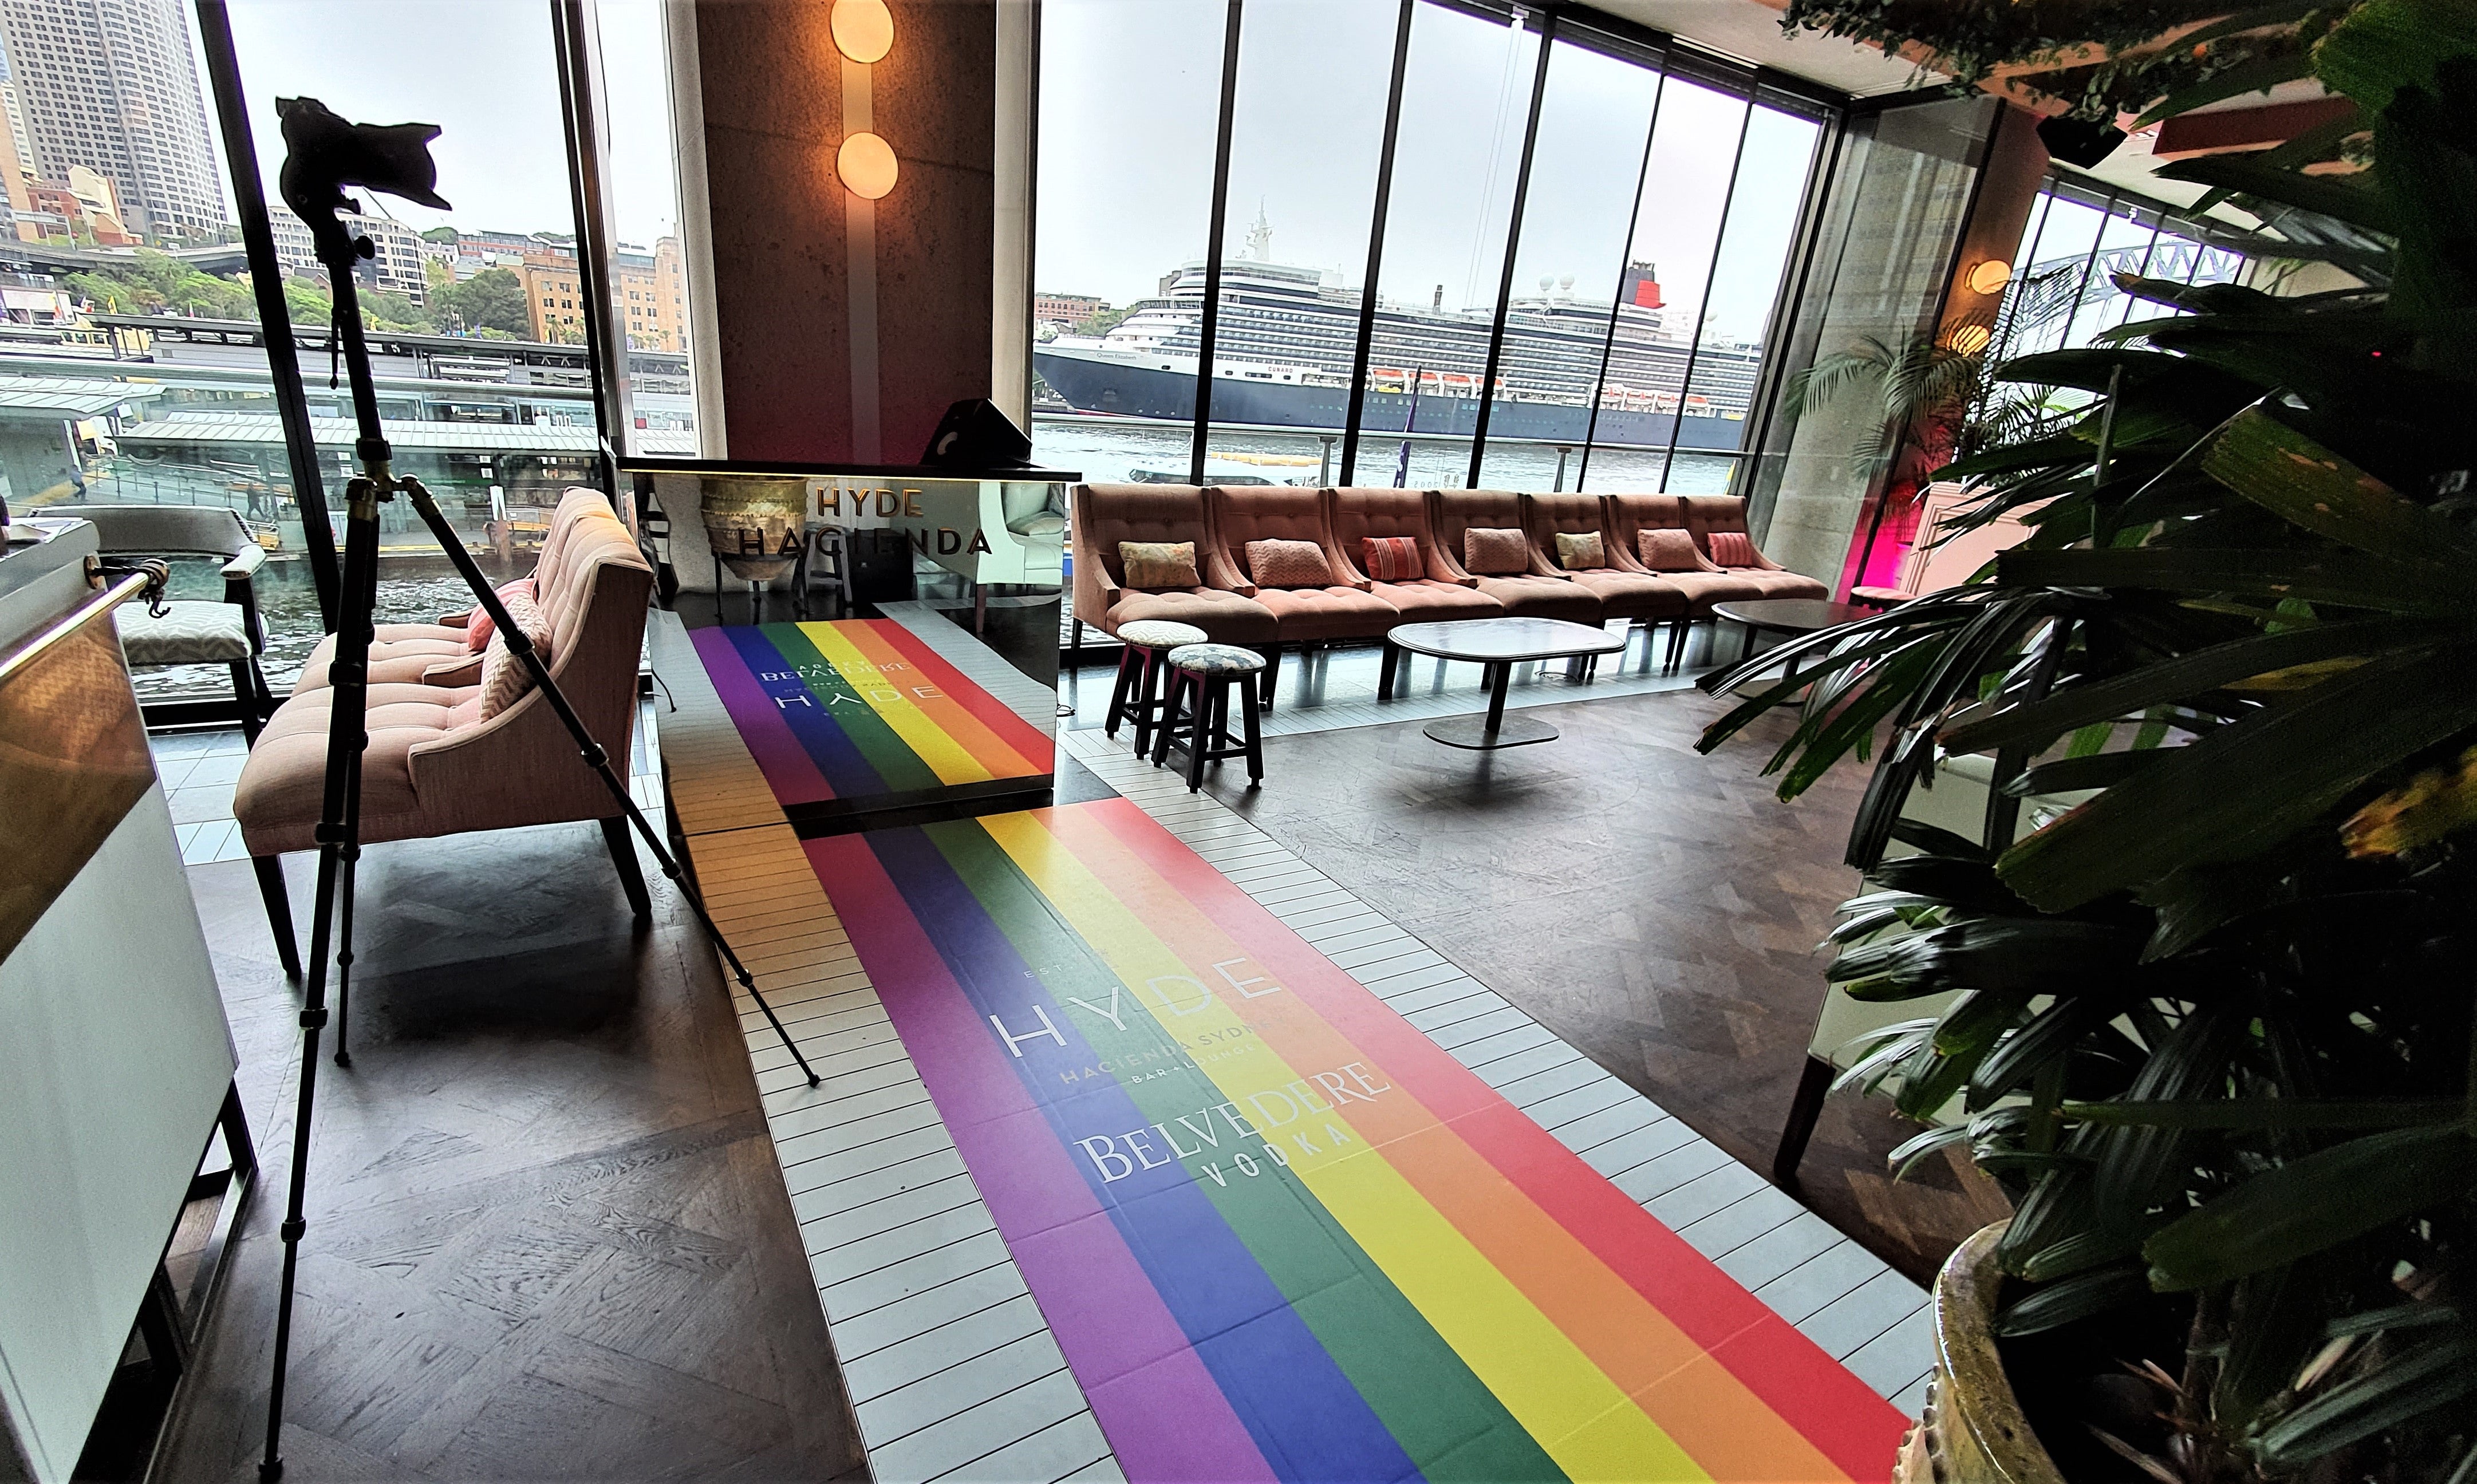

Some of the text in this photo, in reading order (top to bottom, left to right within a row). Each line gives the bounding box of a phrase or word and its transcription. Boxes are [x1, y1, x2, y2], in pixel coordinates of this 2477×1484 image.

[817, 487, 924, 517] HYDE
[738, 527, 992, 556] HACIENDA
[1024, 964, 1074, 978] EST.
[989, 957, 1283, 1058] HYDE
[1059, 1044, 1193, 1085] HACIENDA
[1131, 1069, 1167, 1084] BAR
[1184, 1043, 1256, 1069] LOUNGE
[1073, 1062, 1391, 1183] BELVEDERE
[1201, 1124, 1351, 1187] VODKA
